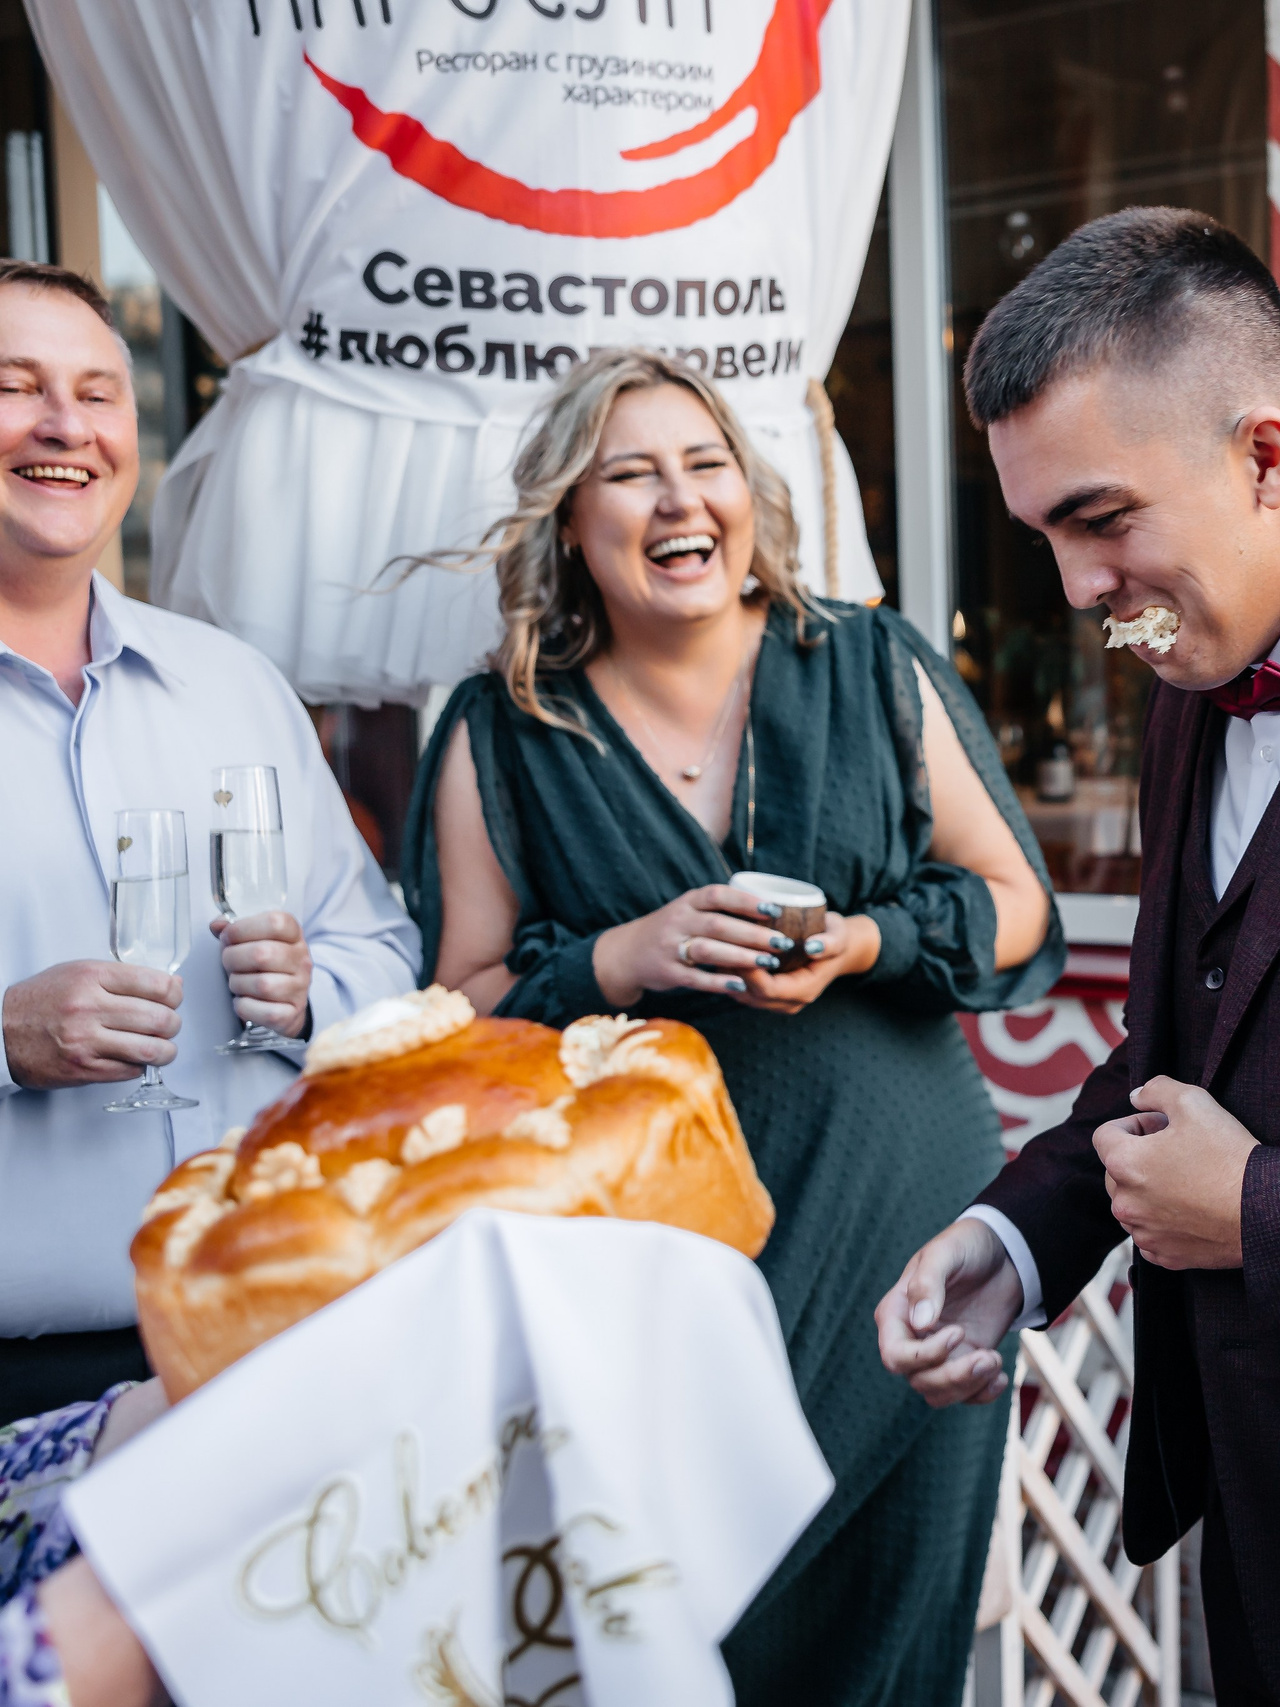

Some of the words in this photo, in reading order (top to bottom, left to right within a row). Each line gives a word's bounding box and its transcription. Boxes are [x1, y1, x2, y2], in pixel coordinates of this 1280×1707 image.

[416, 49, 538, 75] Ресторан
[545, 51, 560, 72] с
[567, 53, 714, 81] грузинским
[562, 83, 713, 112] характером
[363, 251, 785, 317] Севастополь
